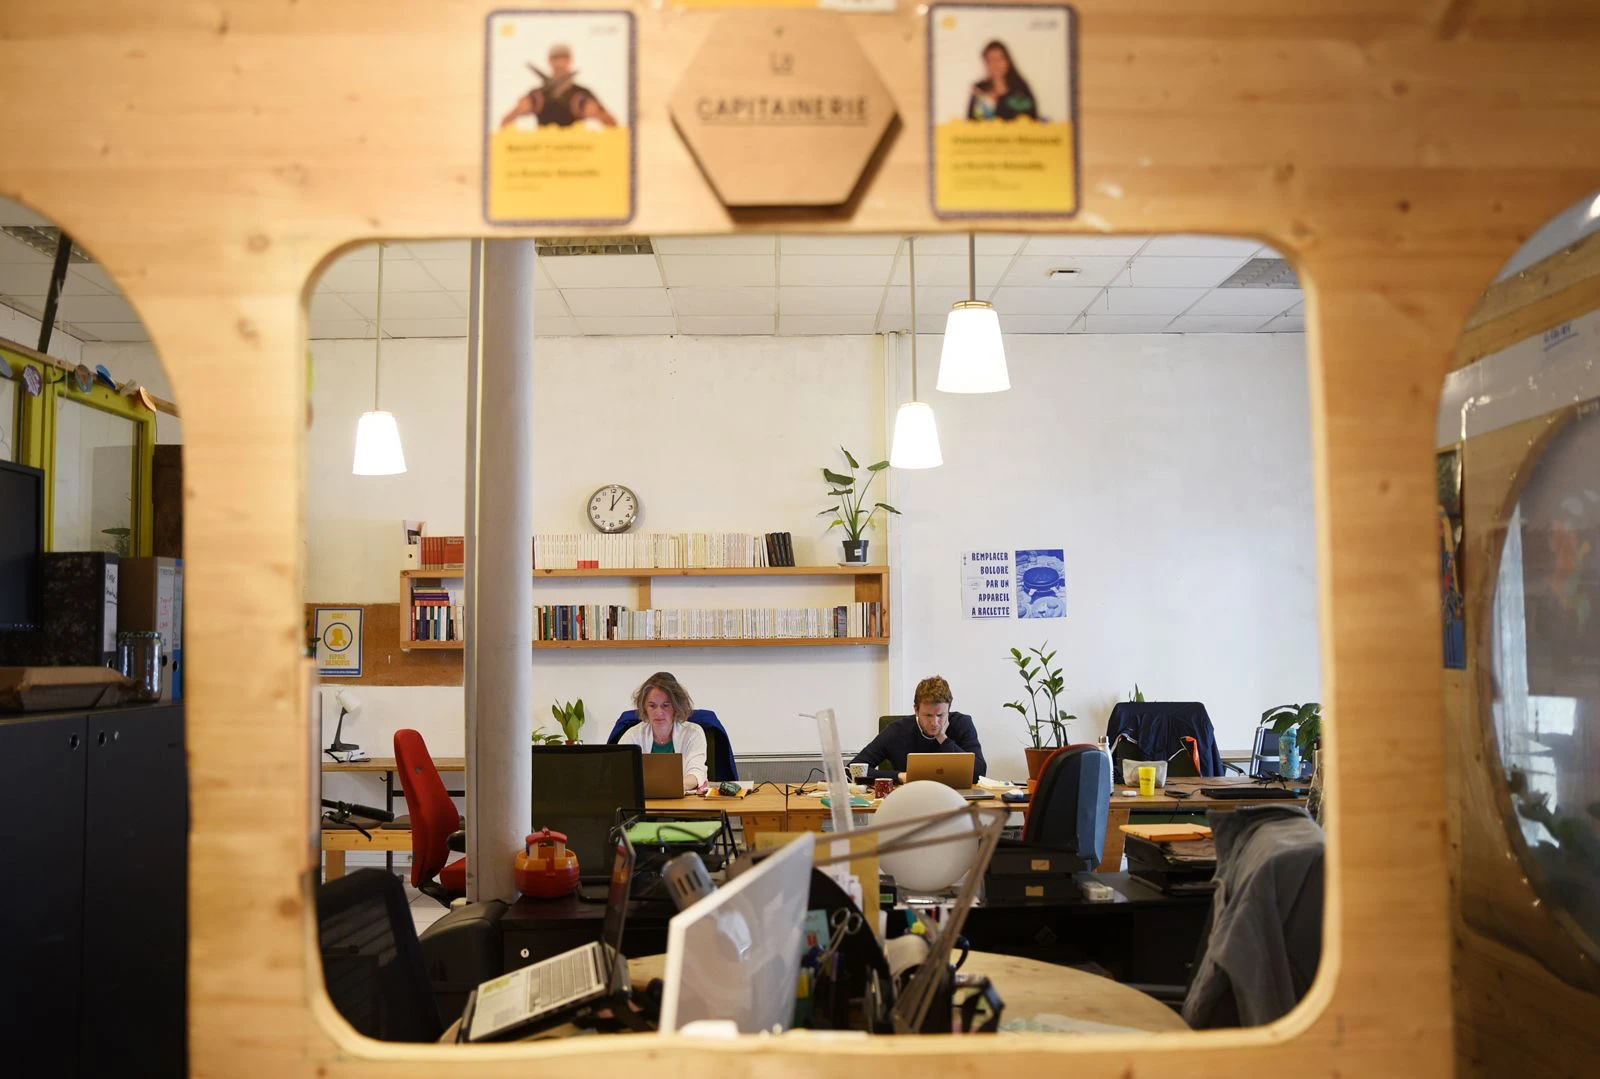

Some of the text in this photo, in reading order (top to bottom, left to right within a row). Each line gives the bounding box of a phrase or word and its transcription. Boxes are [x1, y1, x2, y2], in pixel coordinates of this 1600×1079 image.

[696, 95, 868, 121] CAPITAINERIE
[971, 552, 1009, 561] REMPLACER
[980, 566, 1009, 575] BOLLORE
[986, 580, 999, 588] PAR
[1000, 580, 1010, 588] UN
[978, 593, 1010, 602] APPAREIL
[971, 606, 1010, 616] A RACLETTE
